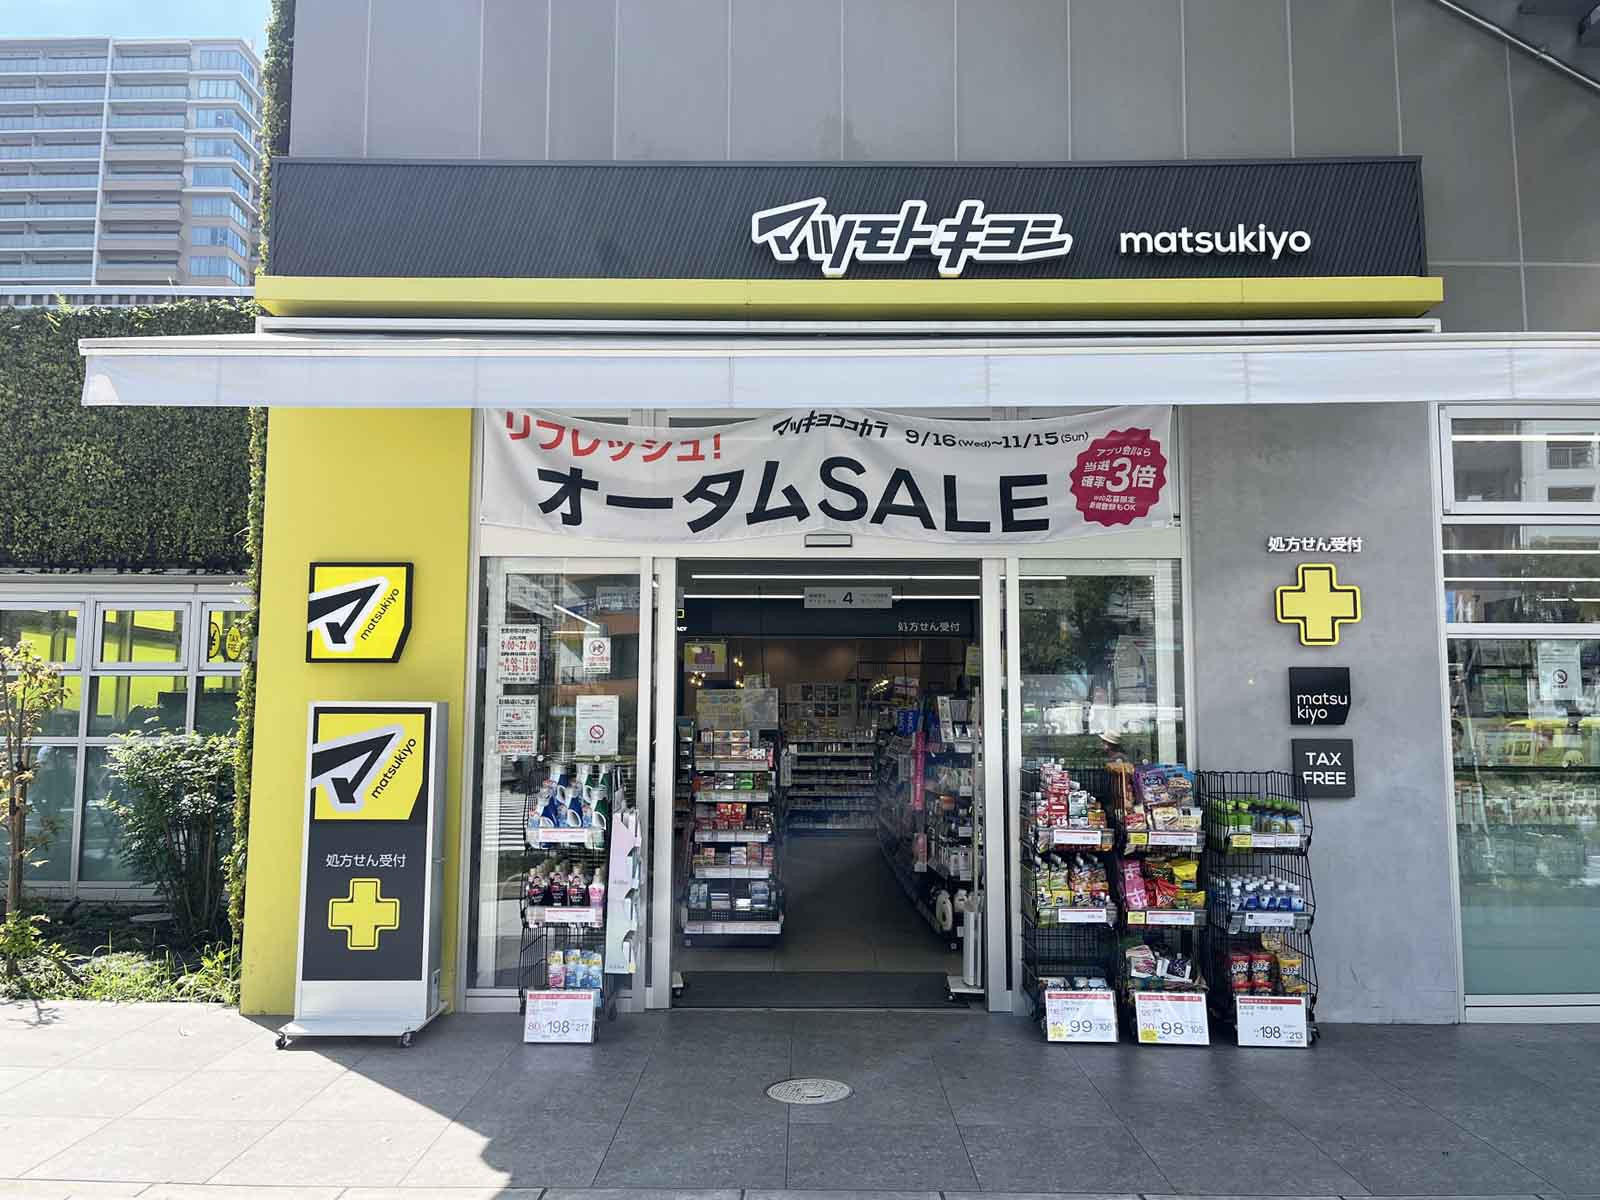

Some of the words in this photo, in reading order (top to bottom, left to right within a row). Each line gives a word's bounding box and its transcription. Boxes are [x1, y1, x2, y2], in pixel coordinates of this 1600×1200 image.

[752, 197, 1073, 277] マツモトキヨシ
[1119, 223, 1311, 260] matsukiyo
[1267, 536, 1363, 553] 処方せん受付
[842, 591, 854, 605] 4
[360, 587, 400, 641] matsukiyo
[897, 621, 961, 633] 処方せん受付
[1297, 692, 1348, 705] matsu
[1297, 705, 1328, 725] kiyo
[1305, 752, 1342, 766] TAX
[371, 736, 418, 800] matsukiyo
[1303, 772, 1347, 785] FREE
[325, 853, 407, 868] 処方せん受付
[547, 1020, 570, 1034] 198
[1070, 1020, 1092, 1033] 99
[1160, 1021, 1184, 1035] 98
[1259, 1025, 1282, 1039] 198
[1288, 1031, 1304, 1040] 213
